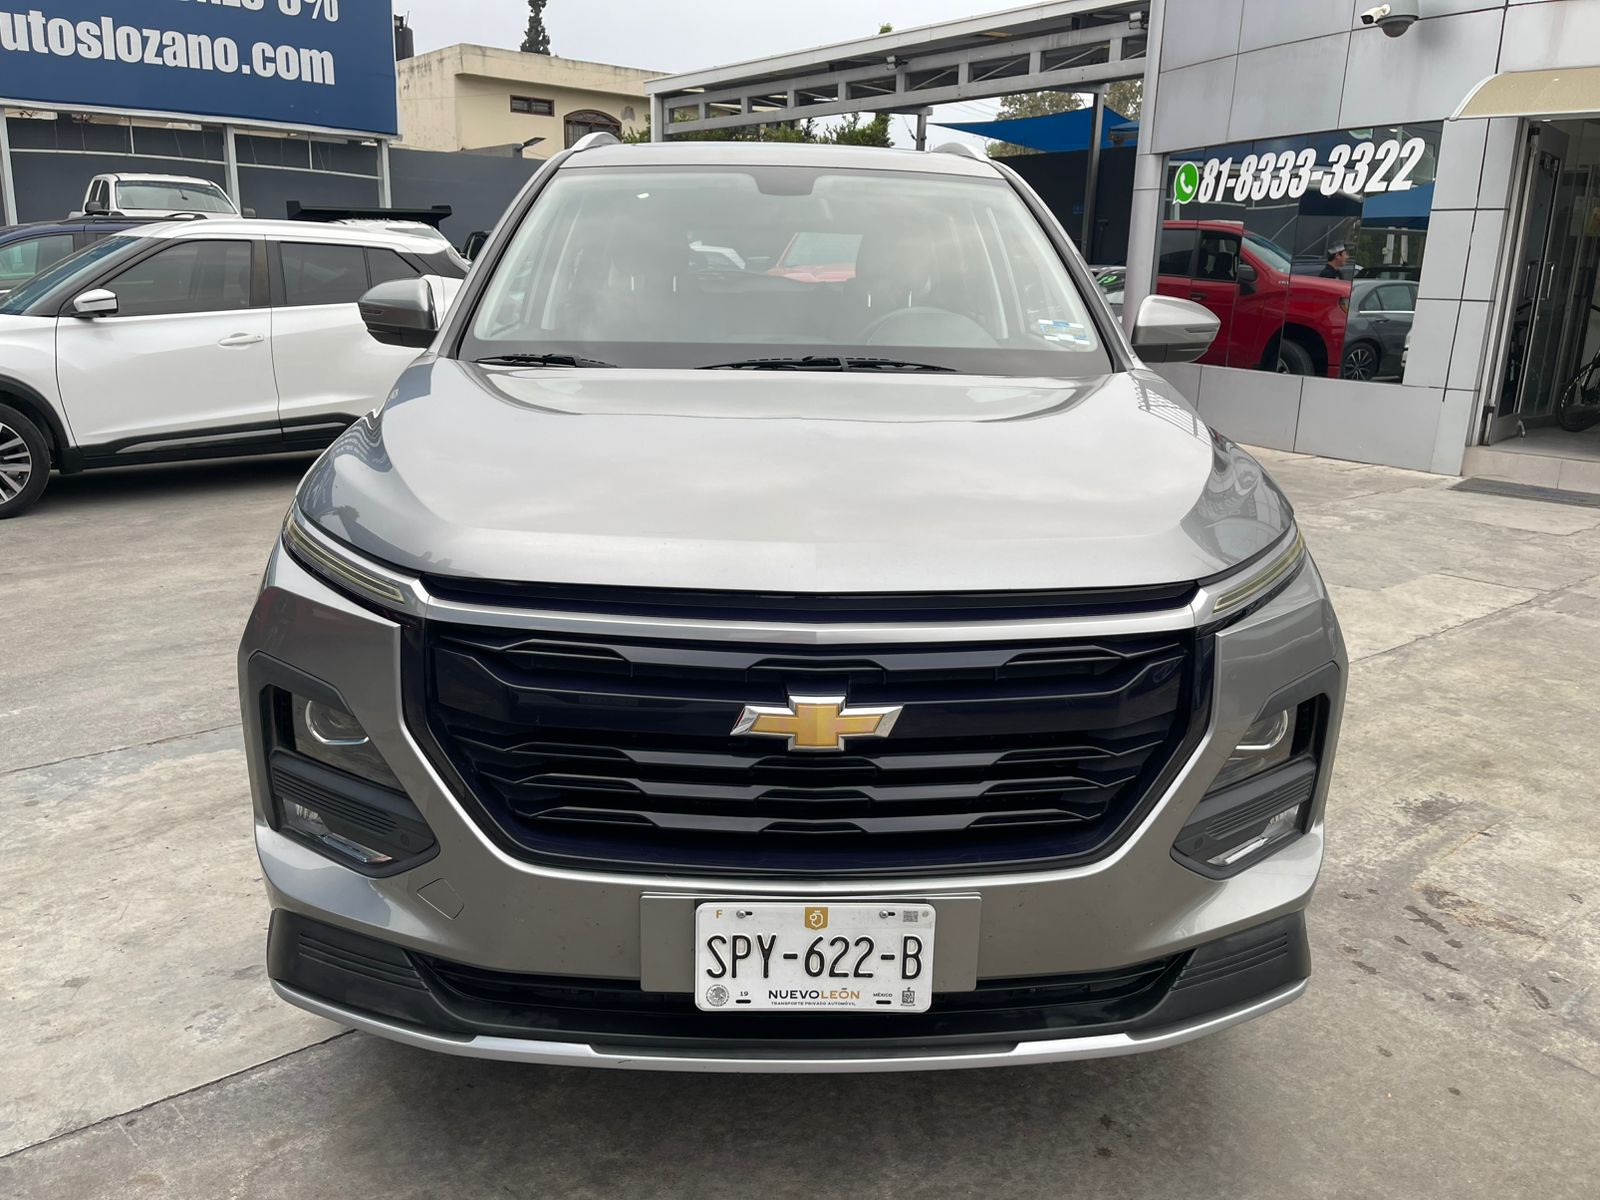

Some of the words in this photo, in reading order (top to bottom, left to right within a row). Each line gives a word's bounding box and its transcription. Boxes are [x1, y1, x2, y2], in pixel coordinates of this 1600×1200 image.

[0, 10, 335, 86] utoslozano.com
[1197, 137, 1426, 204] 81-8333-3322
[715, 909, 723, 919] F
[706, 934, 923, 980] SPY-622-B
